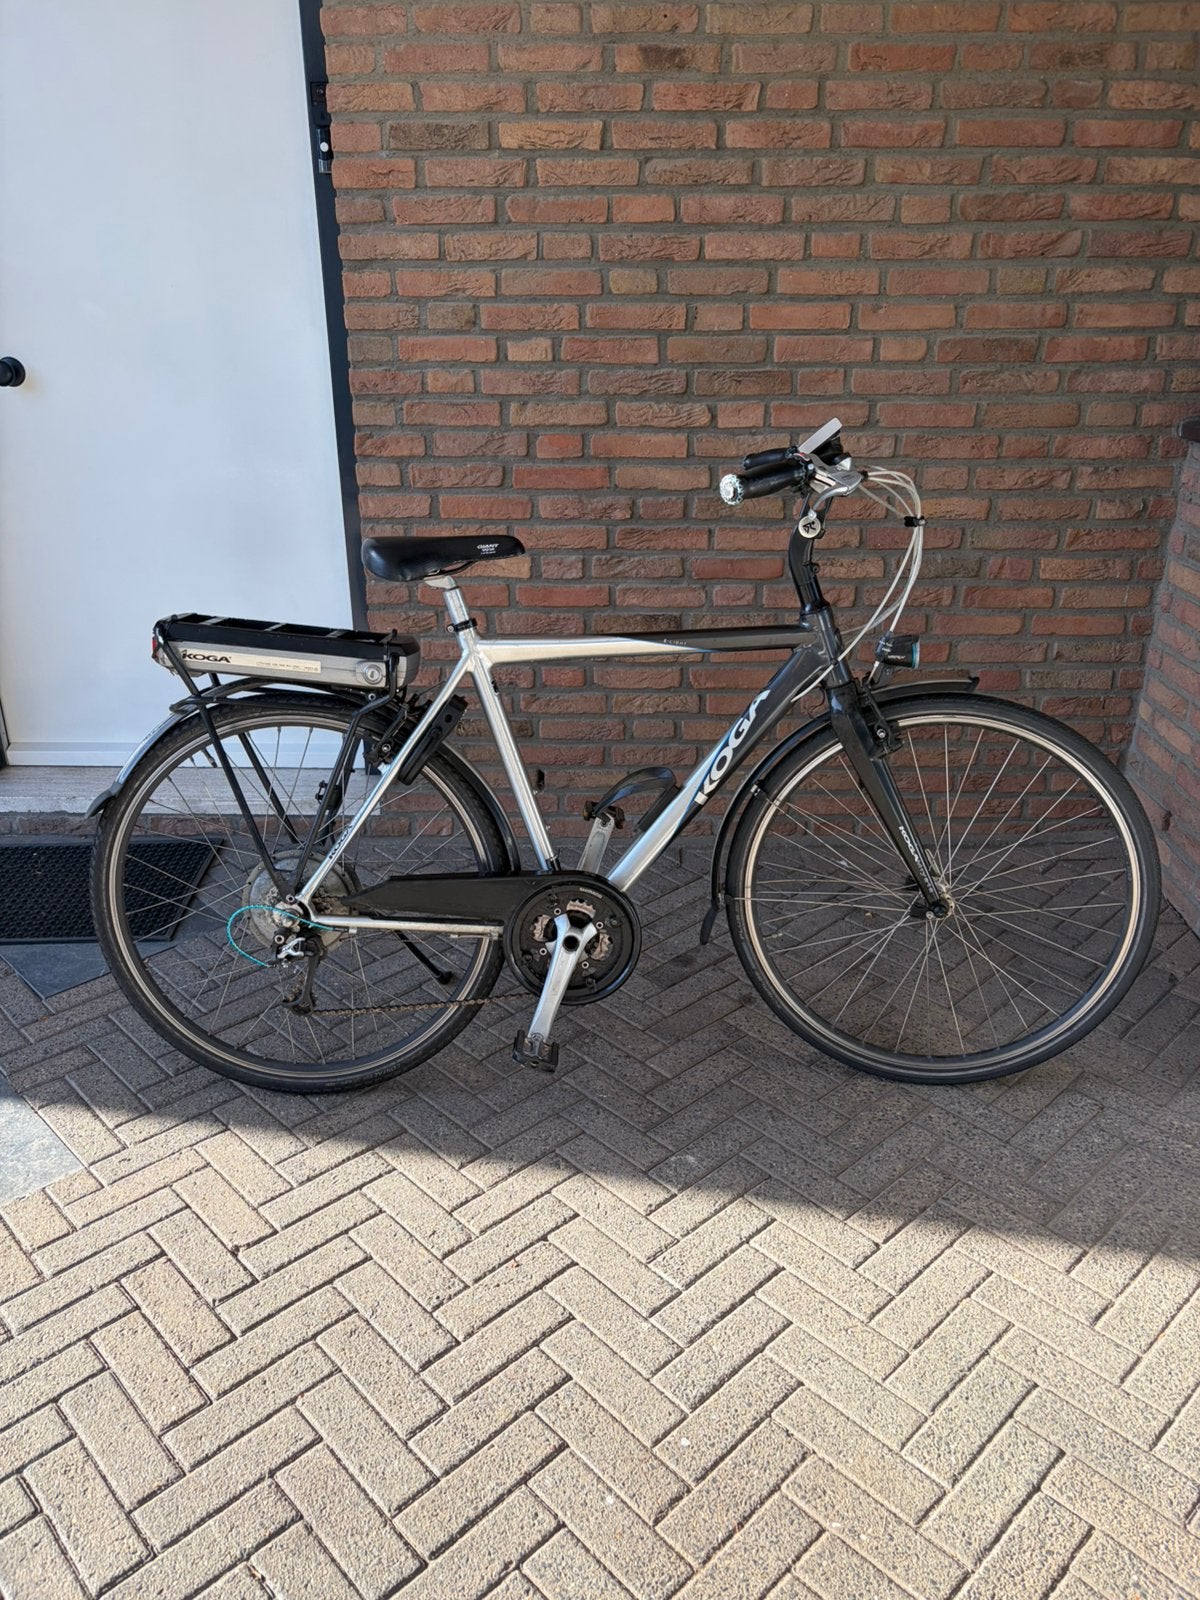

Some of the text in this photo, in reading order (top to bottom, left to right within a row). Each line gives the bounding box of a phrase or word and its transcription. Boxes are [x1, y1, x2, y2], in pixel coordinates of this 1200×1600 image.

[182, 649, 231, 663] KOGA
[694, 689, 771, 805] KOGA
[899, 826, 918, 861] KOGA
